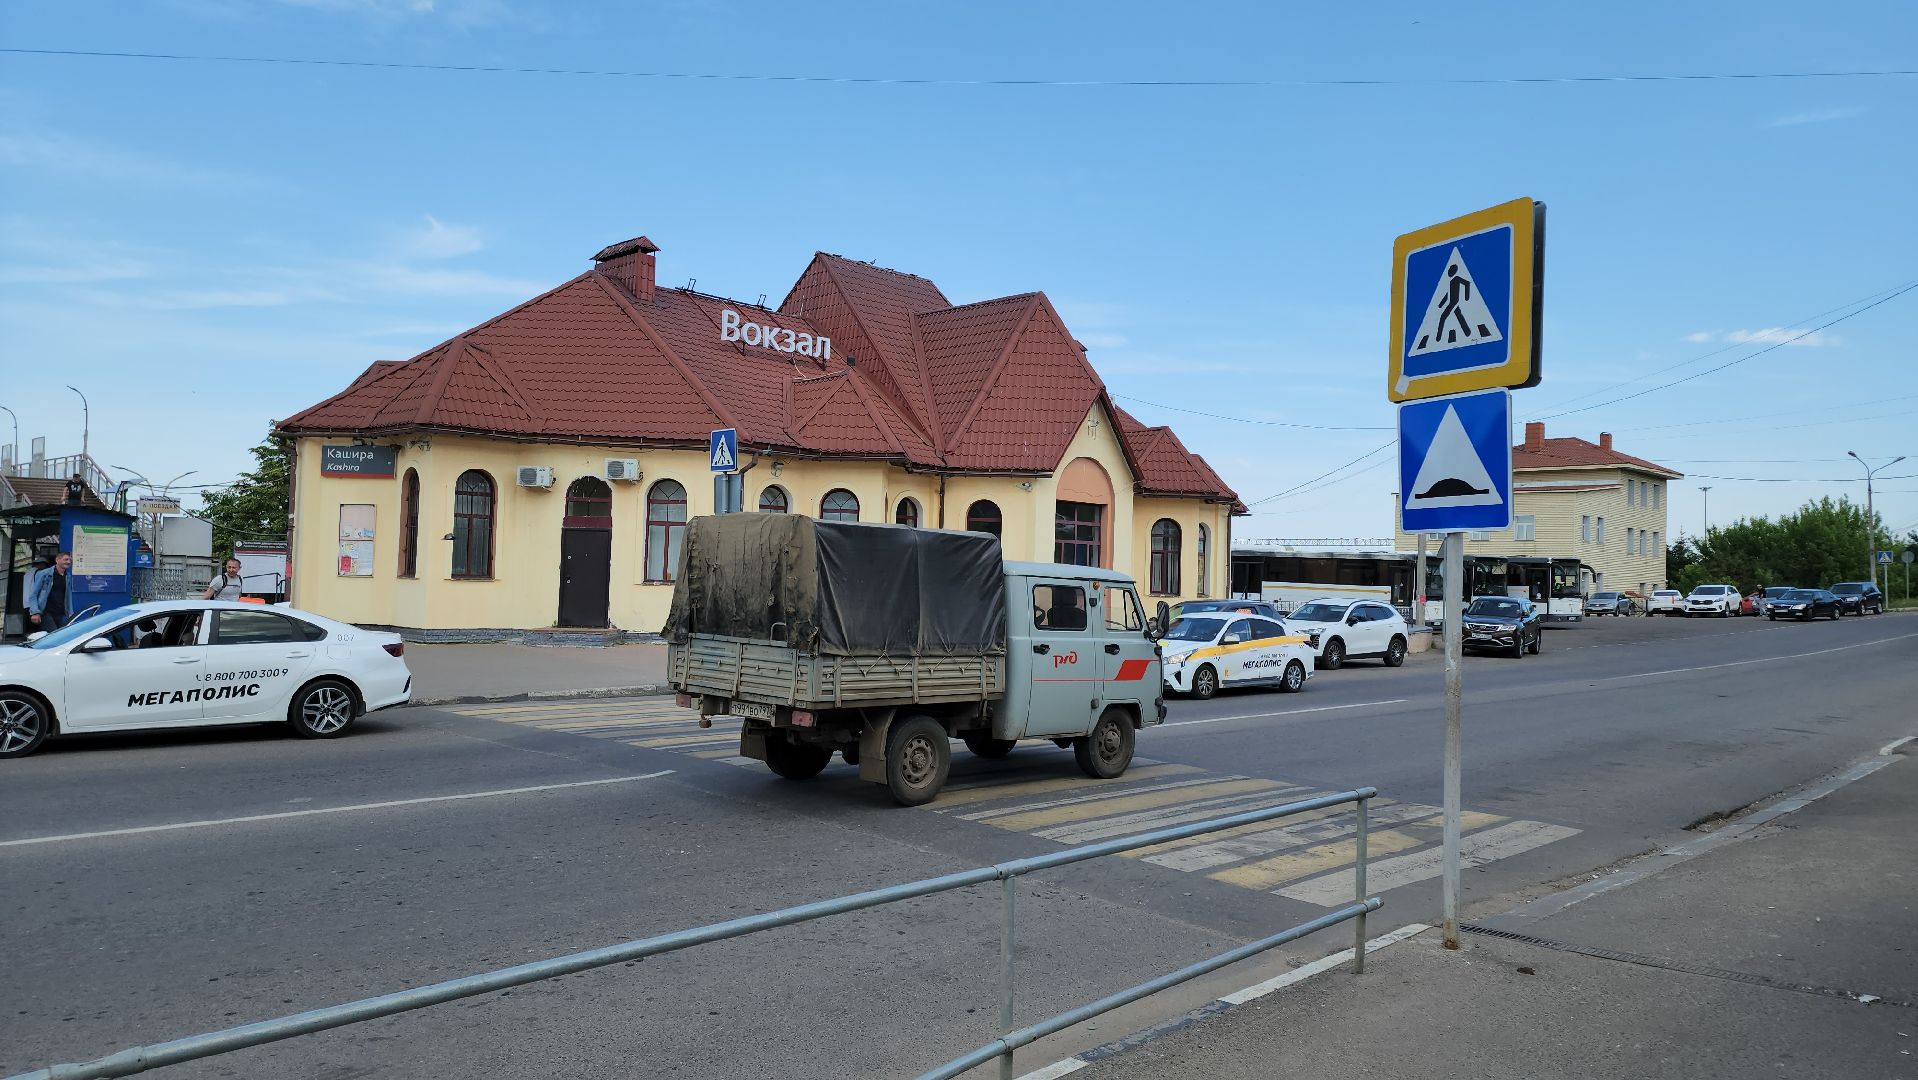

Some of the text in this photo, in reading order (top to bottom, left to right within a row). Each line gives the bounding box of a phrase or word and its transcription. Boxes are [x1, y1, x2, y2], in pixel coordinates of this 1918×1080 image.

[721, 309, 831, 360] Вокзал
[327, 448, 374, 462] Кашира
[326, 463, 360, 472] Kashira
[204, 673, 212, 682] 8
[213, 671, 236, 681] 800
[238, 670, 258, 680] 700
[127, 684, 260, 707] МЕГАПОЛИС
